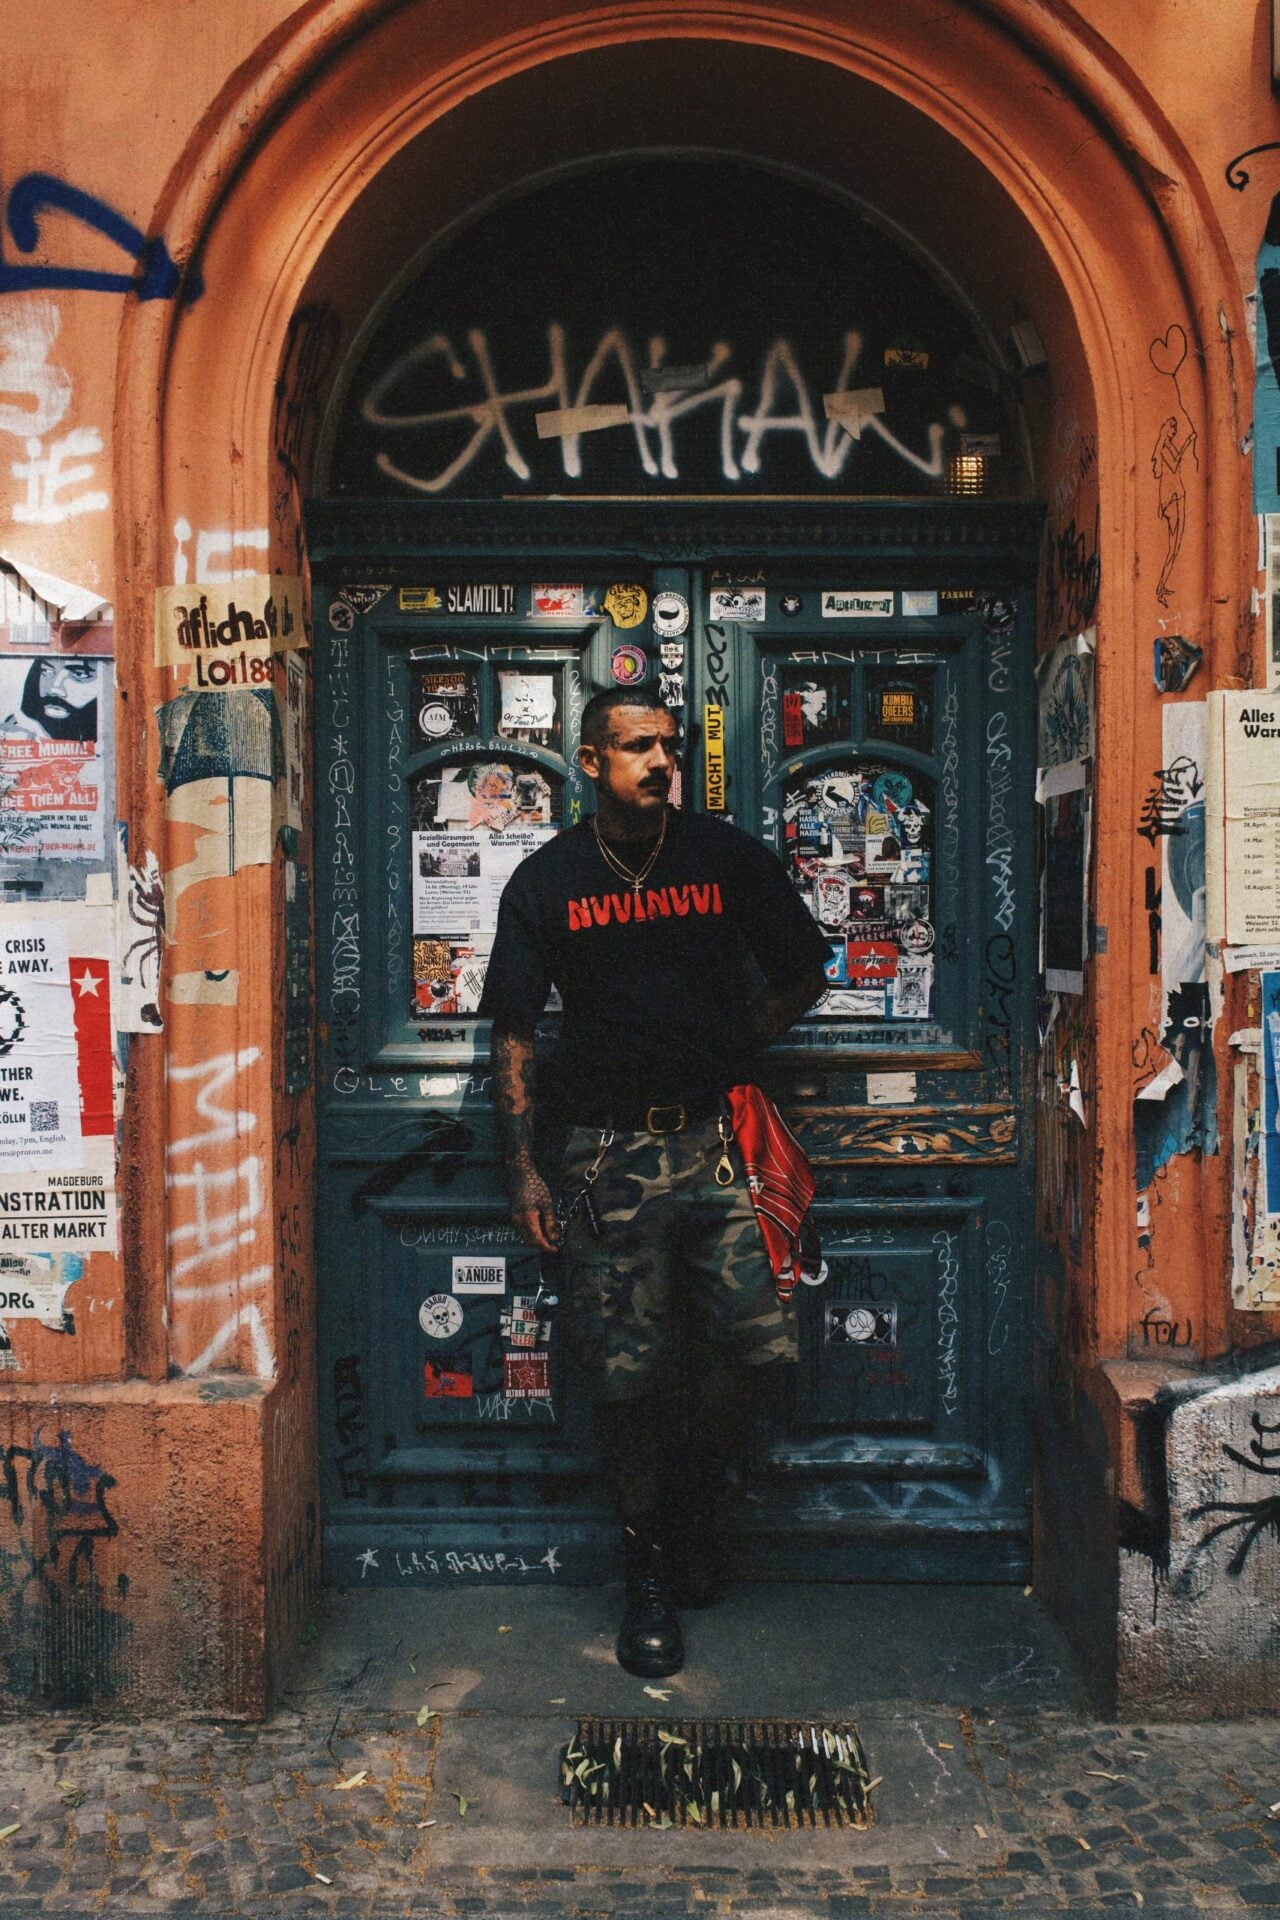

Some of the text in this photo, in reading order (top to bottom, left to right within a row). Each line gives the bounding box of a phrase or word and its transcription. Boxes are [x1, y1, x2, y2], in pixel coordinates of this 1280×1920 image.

[447, 584, 514, 613] SLAMTILT!
[882, 694, 914, 706] KUMBIA
[881, 705, 914, 717] QUEERS
[1239, 708, 1275, 723] Alles
[707, 707, 722, 740] MUT
[39, 741, 88, 757] MUMIA!
[708, 752, 723, 807] MACHT
[29, 792, 65, 807] THEM
[69, 790, 97, 805] ALL!
[66, 814, 78, 822] THE
[79, 814, 88, 822] US
[799, 822, 815, 830] ALLE
[441, 841, 480, 849] Gegenwehr
[490, 839, 520, 847] Warum?
[5, 938, 46, 954] CRISIS
[8, 959, 53, 974] AWAY.
[39, 1134, 66, 1144] English
[48, 1176, 104, 1187] MAGDEBURG
[2, 1222, 107, 1240] ALTER MARKT
[515, 1322, 526, 1333] IS
